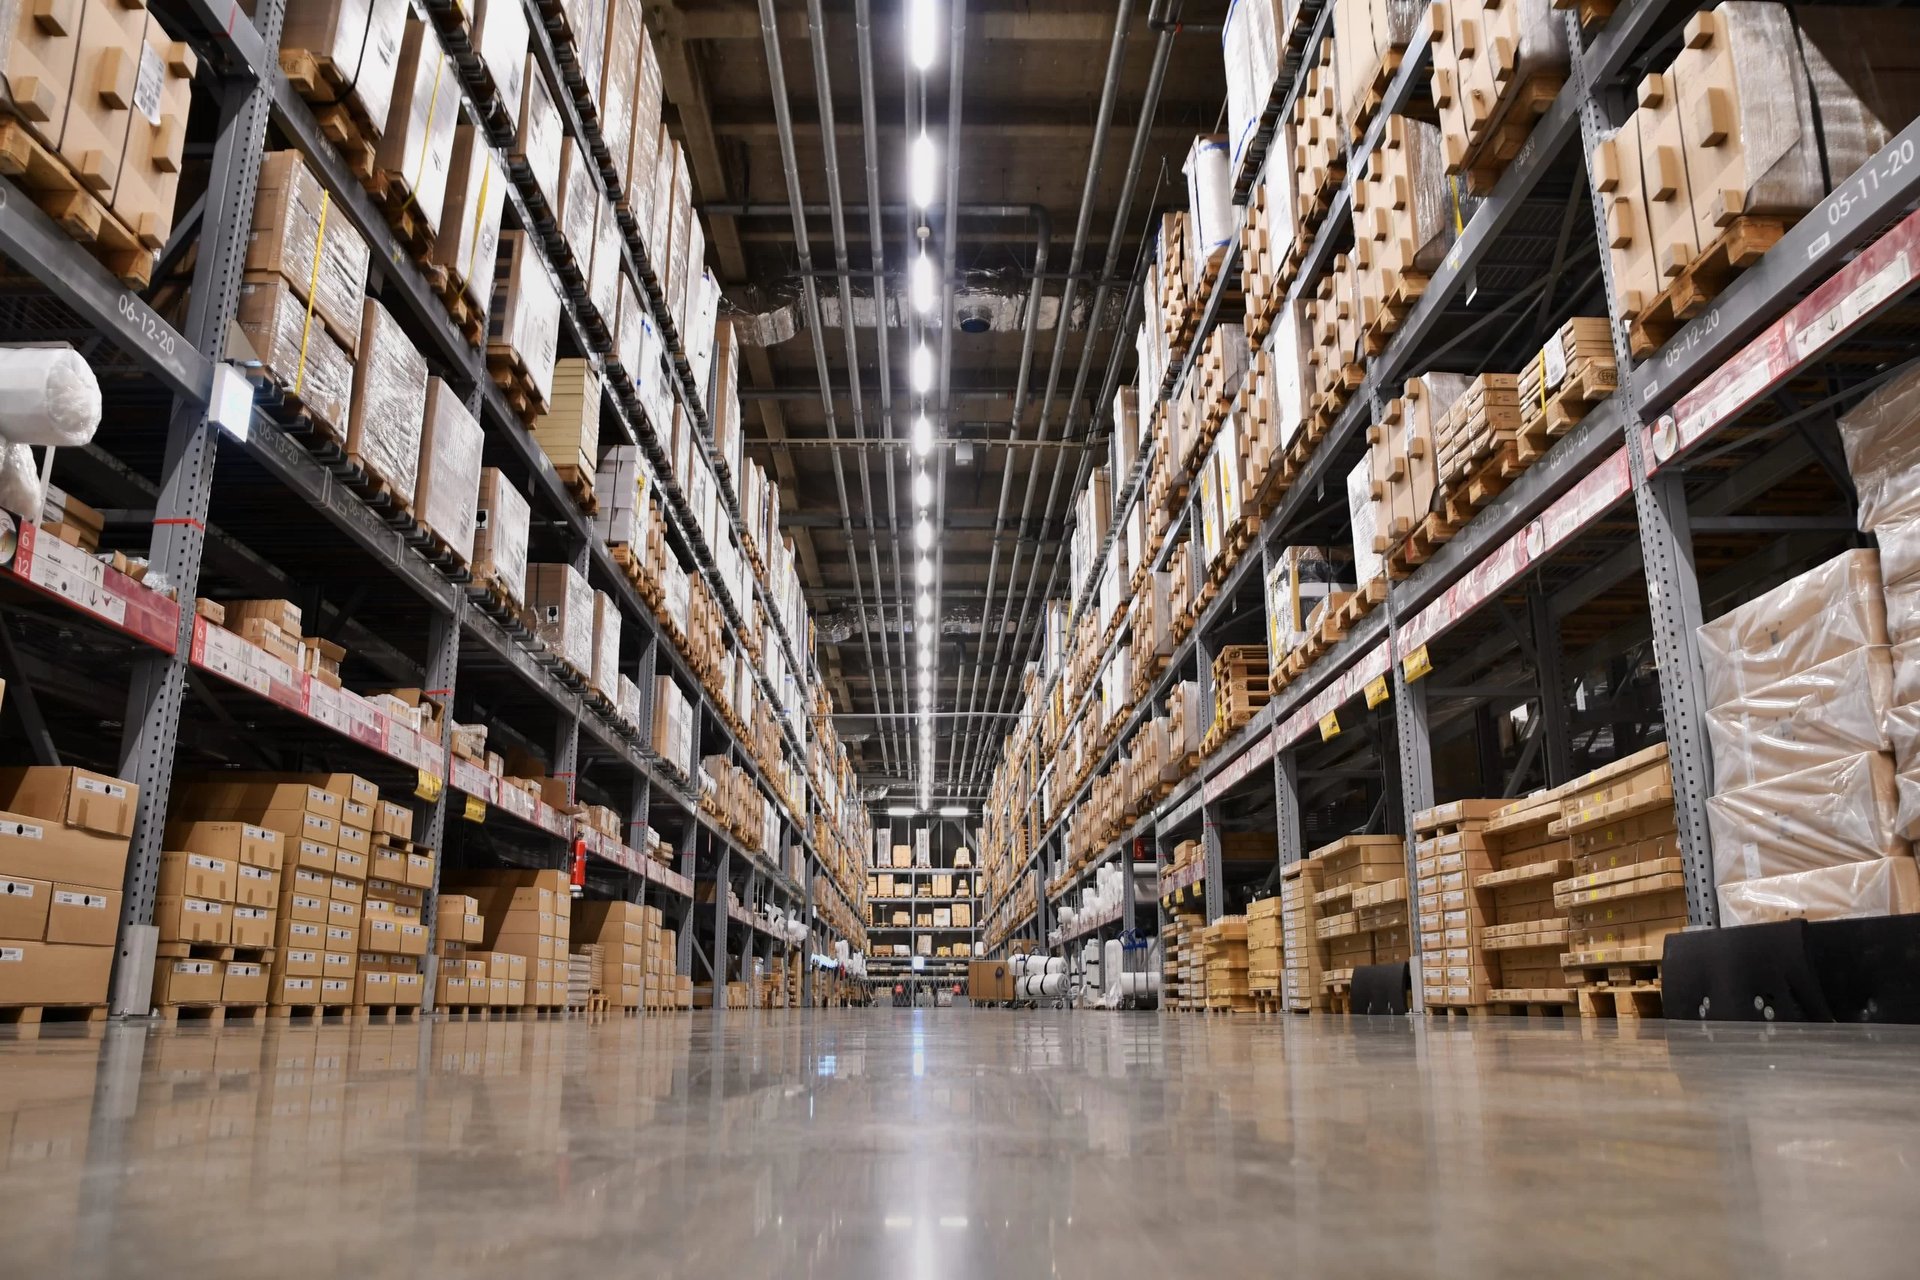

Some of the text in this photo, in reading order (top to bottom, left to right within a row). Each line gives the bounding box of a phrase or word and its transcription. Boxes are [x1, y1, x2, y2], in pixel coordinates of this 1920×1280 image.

[1828, 139, 1915, 226] 05-11-20
[118, 294, 175, 355] 06-12-20
[1665, 309, 1720, 368] 05-12-20
[260, 421, 299, 465] 06-13-20
[1550, 426, 1589, 470] 05-13-20
[22, 531, 30, 550] 6
[17, 556, 29, 576] 12
[197, 628, 204, 640] 6
